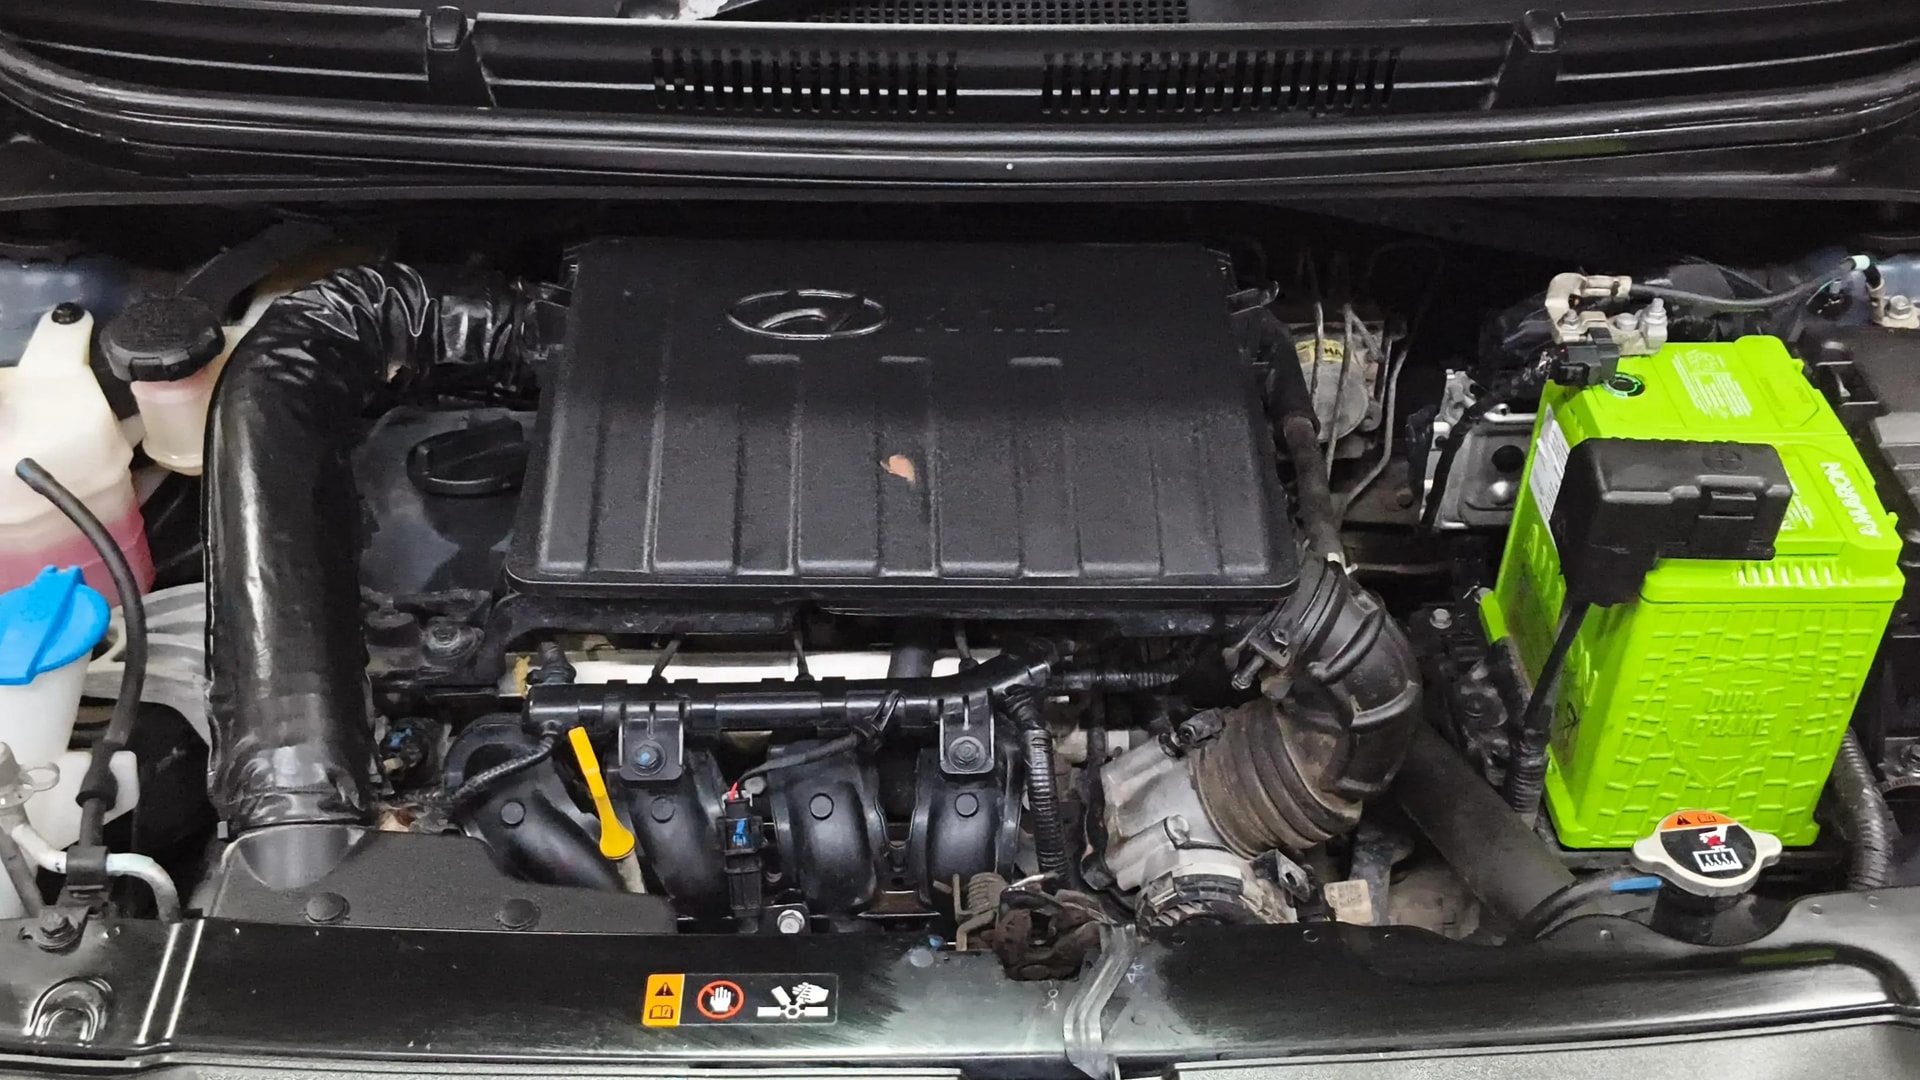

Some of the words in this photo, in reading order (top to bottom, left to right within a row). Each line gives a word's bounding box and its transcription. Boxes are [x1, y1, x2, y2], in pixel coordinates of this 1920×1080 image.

[1820, 461, 1882, 537] AMARON
[1706, 691, 1763, 713] DURA
[1689, 714, 1777, 737] FRAME
